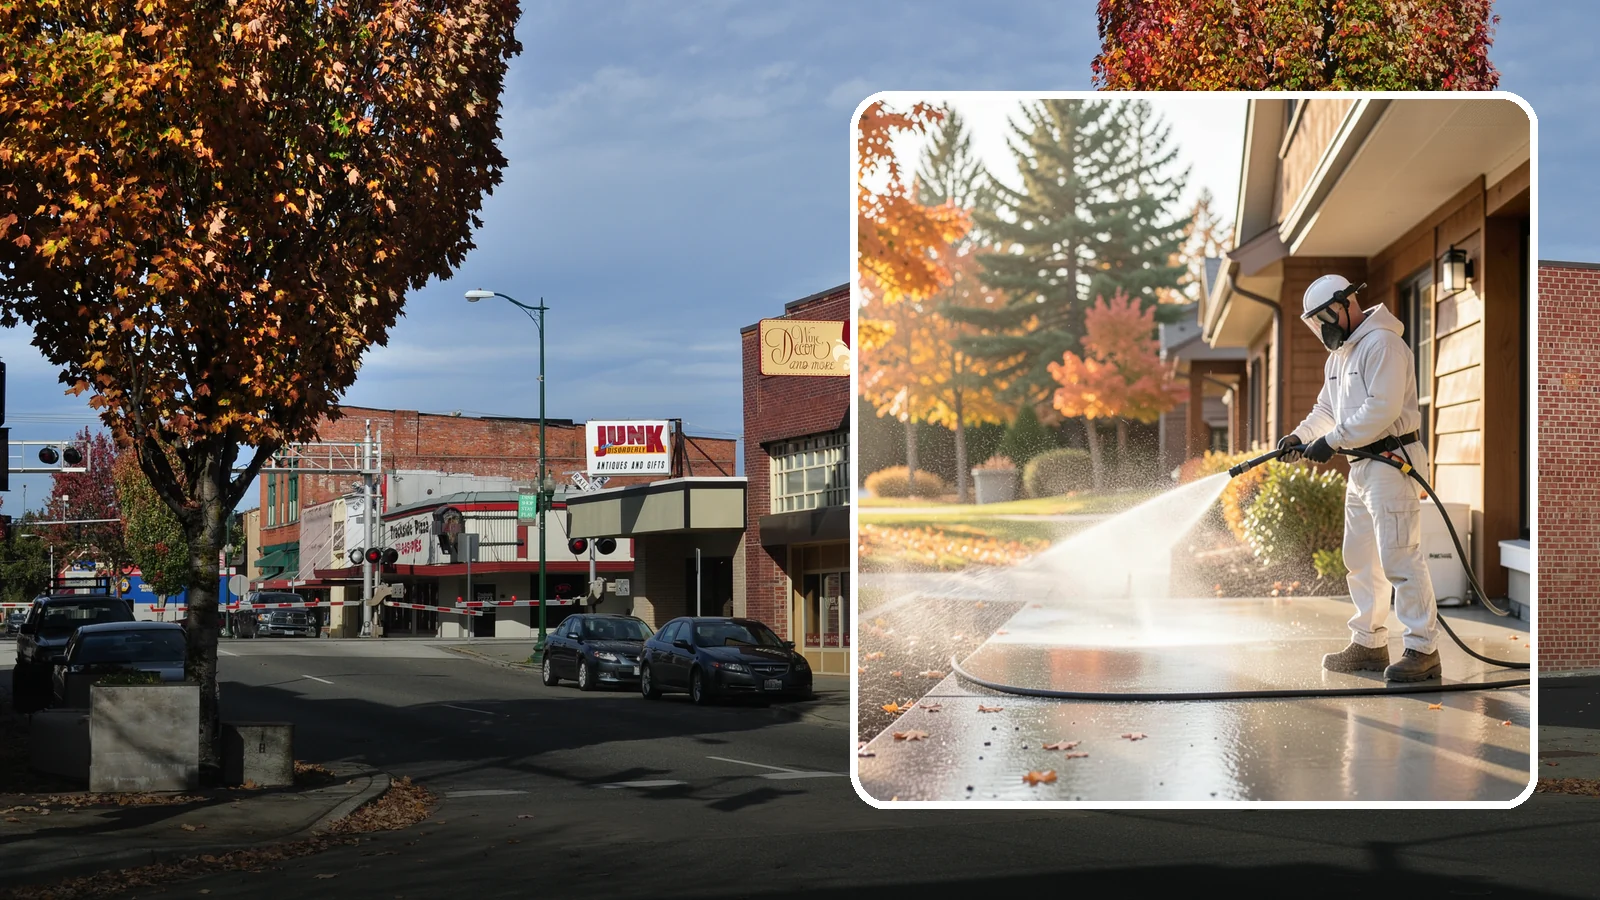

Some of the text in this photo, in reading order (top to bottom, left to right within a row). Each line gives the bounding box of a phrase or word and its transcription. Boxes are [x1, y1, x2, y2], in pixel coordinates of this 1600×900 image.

[595, 425, 665, 457] JUNK
[607, 445, 646, 454] DISORDERLY
[597, 460, 666, 470] ANTIQUES AND GIFTS
[352, 498, 365, 511] CRO
[390, 519, 429, 540] Trackside Pizza
